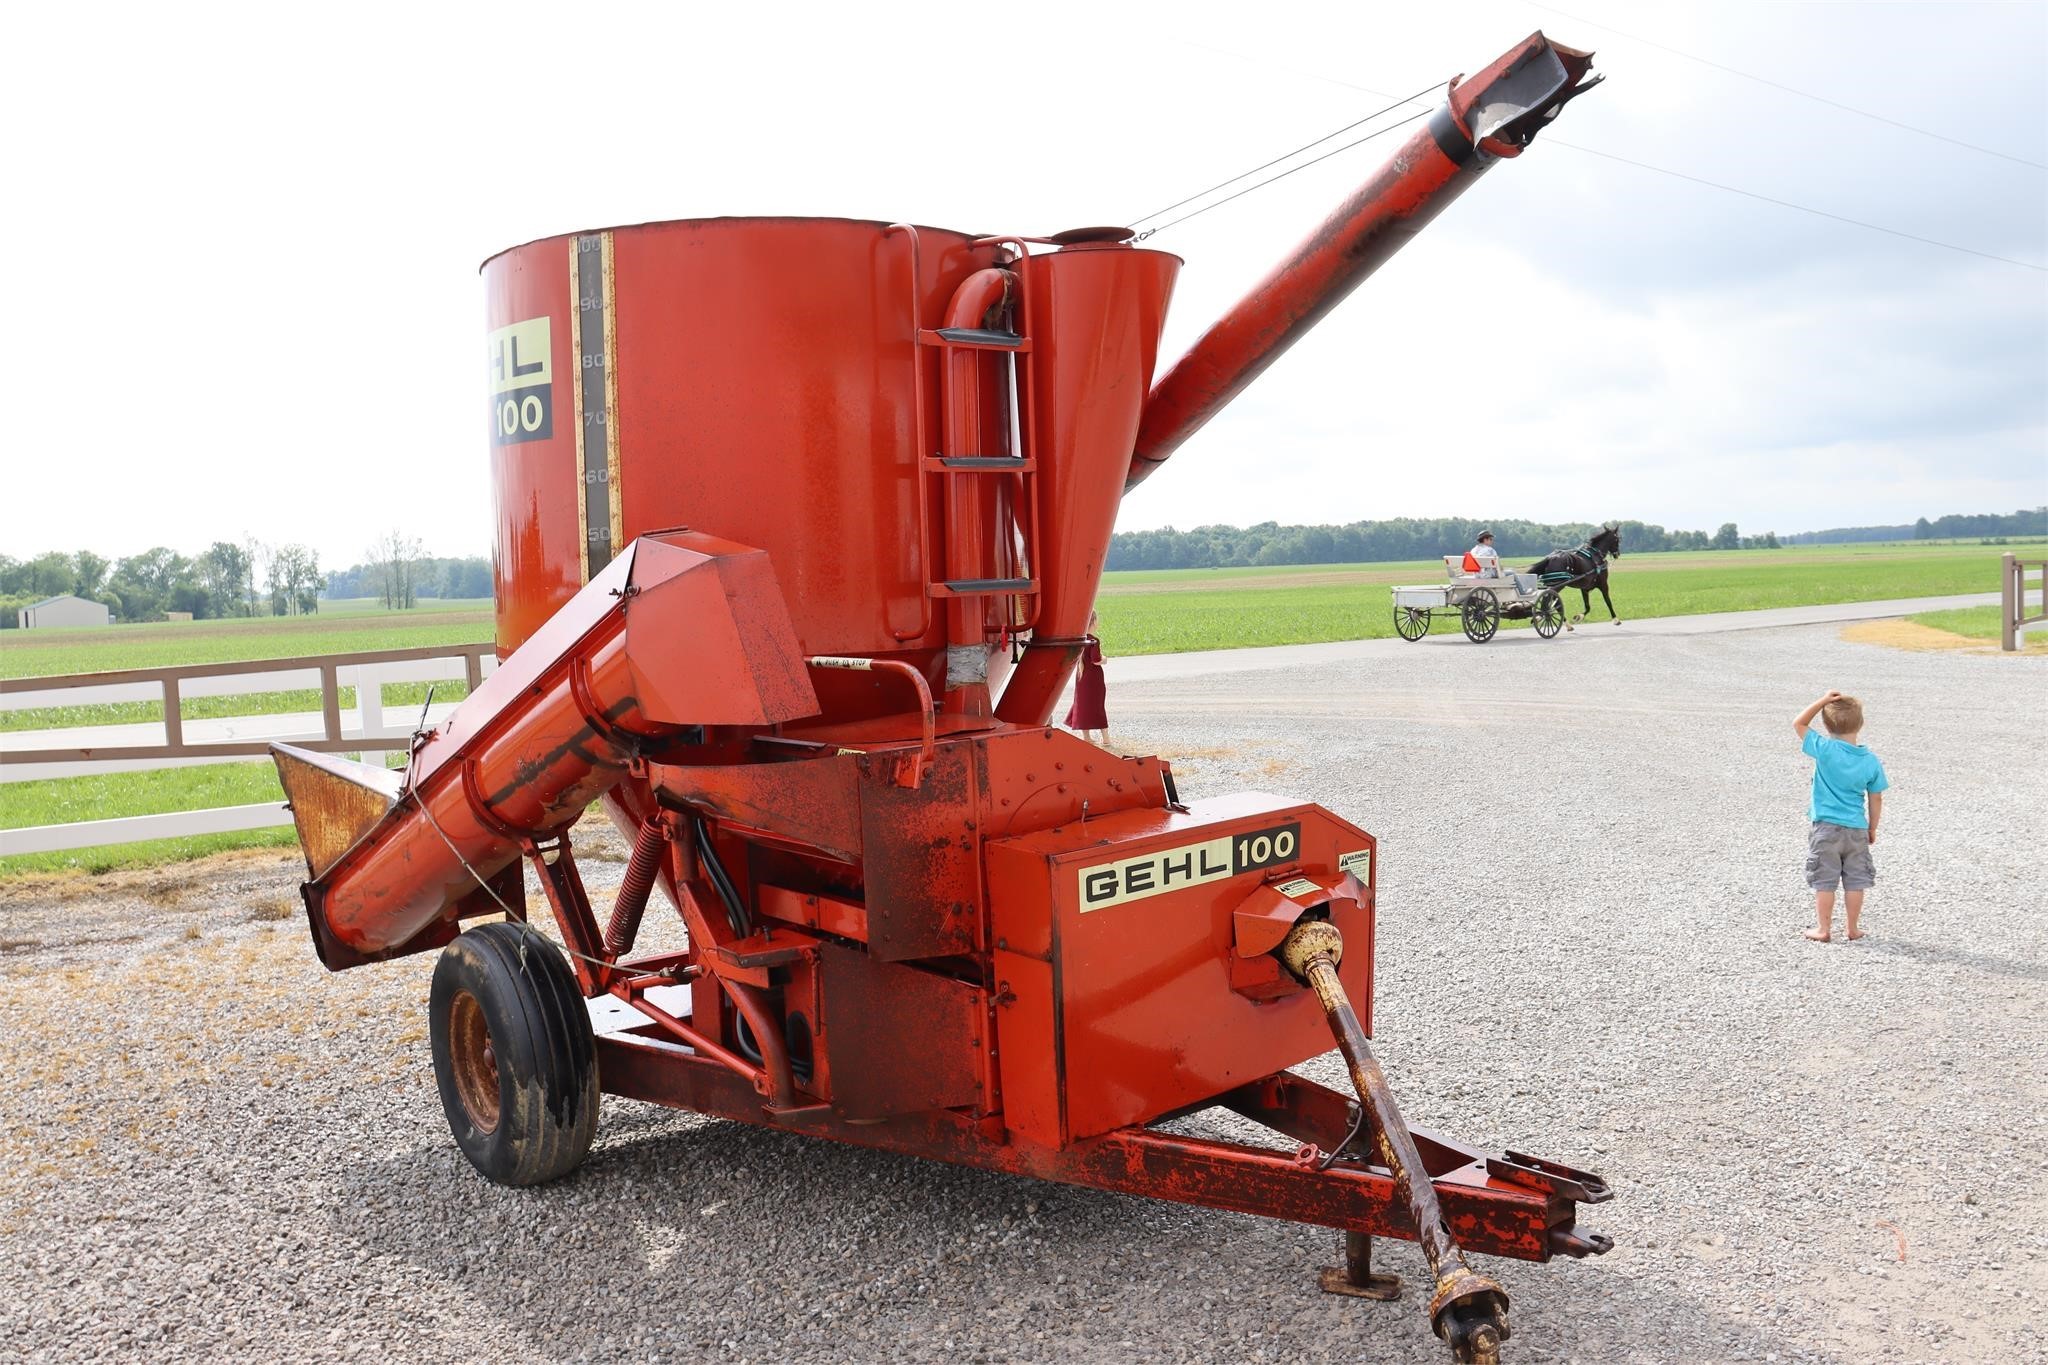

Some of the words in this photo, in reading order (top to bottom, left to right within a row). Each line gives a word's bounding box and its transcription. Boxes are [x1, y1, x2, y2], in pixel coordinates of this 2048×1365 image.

[580, 296, 603, 312] 90
[495, 394, 544, 437] 100
[584, 411, 606, 426] 70
[585, 469, 608, 485] 60
[588, 527, 611, 542] 50
[1347, 851, 1369, 860] WARNING
[1085, 849, 1227, 902] GEHL
[1239, 831, 1294, 867] 100
